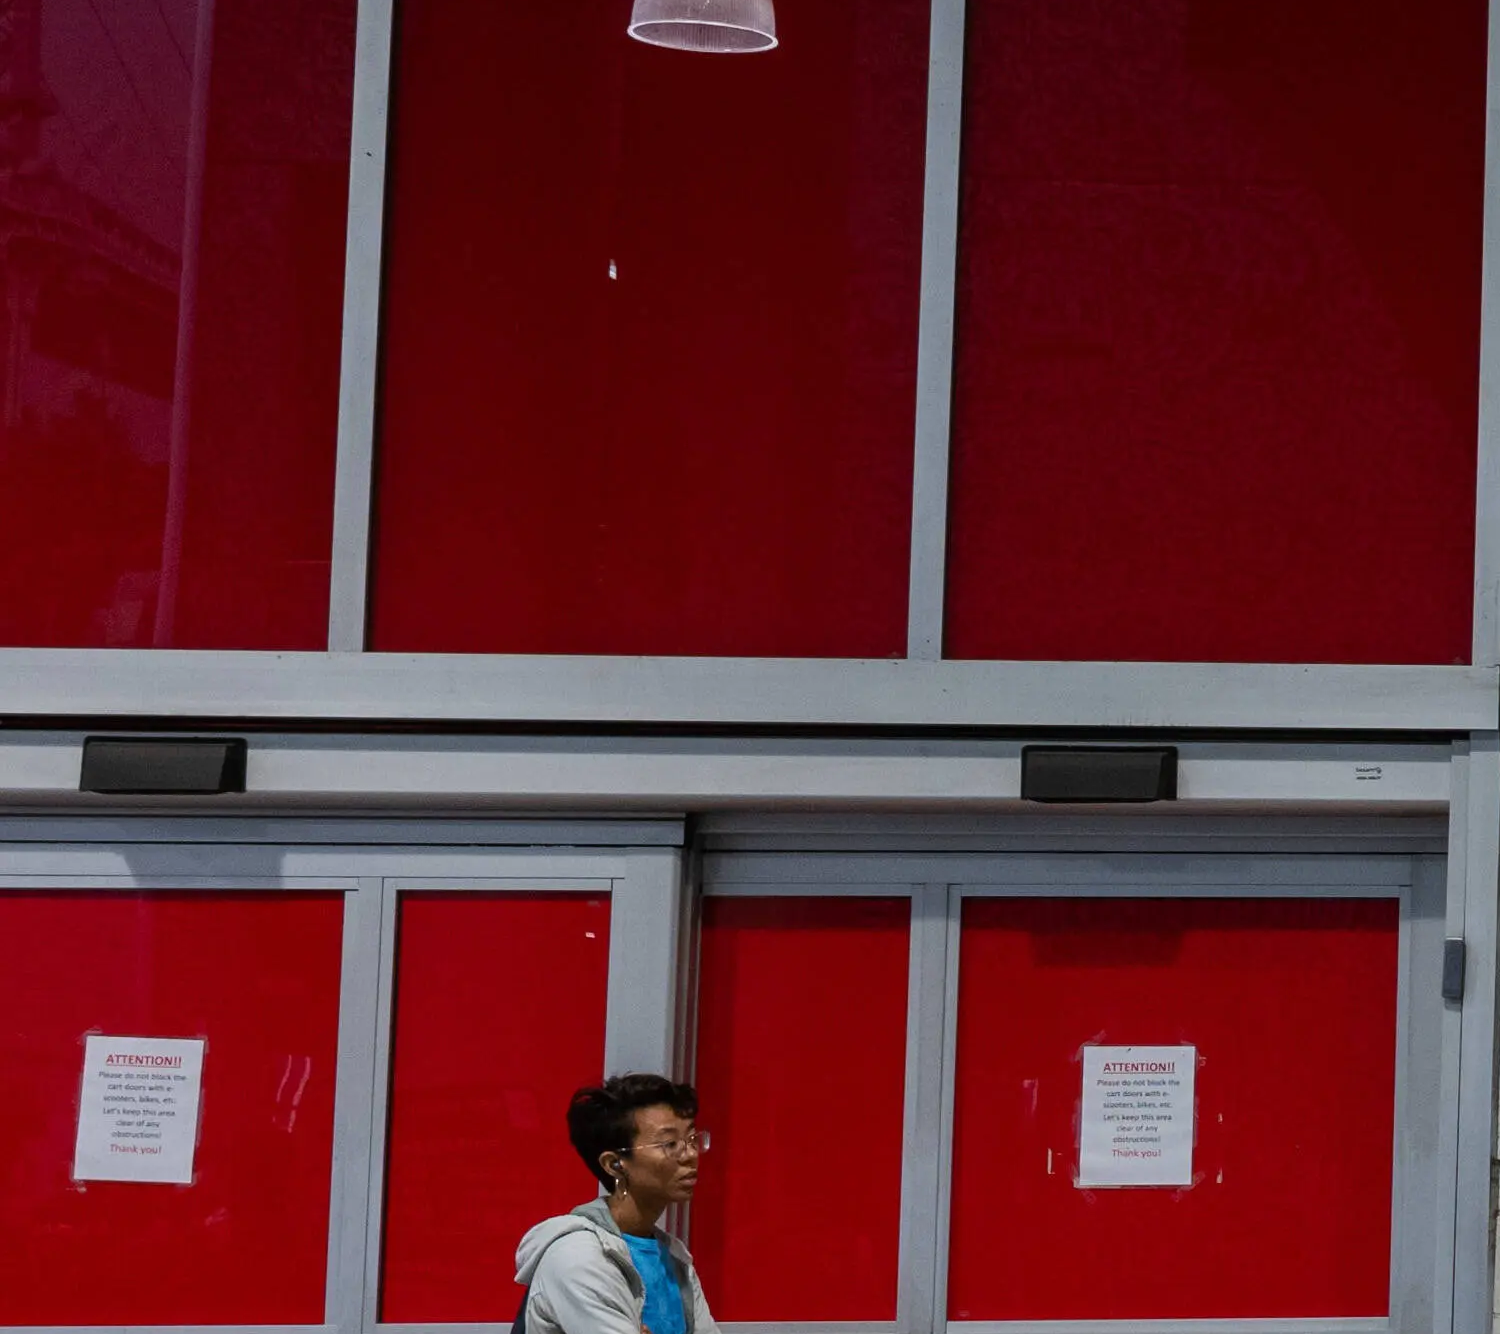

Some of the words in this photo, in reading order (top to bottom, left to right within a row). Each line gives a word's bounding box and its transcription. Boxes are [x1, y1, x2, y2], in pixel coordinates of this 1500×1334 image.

[106, 1054, 182, 1068] ATTENTION!!
[1103, 1062, 1175, 1074] ATTENTION!!
[98, 1071, 123, 1079] Please
[124, 1072, 134, 1080] do
[1096, 1079, 1119, 1087] Please
[1121, 1079, 1131, 1087] do
[122, 1109, 140, 1117] keep
[1122, 1114, 1139, 1122] keep
[109, 1143, 138, 1154] Thank
[141, 1145, 162, 1155] you!
[1112, 1149, 1139, 1158] Thank
[1141, 1149, 1162, 1159] you!
